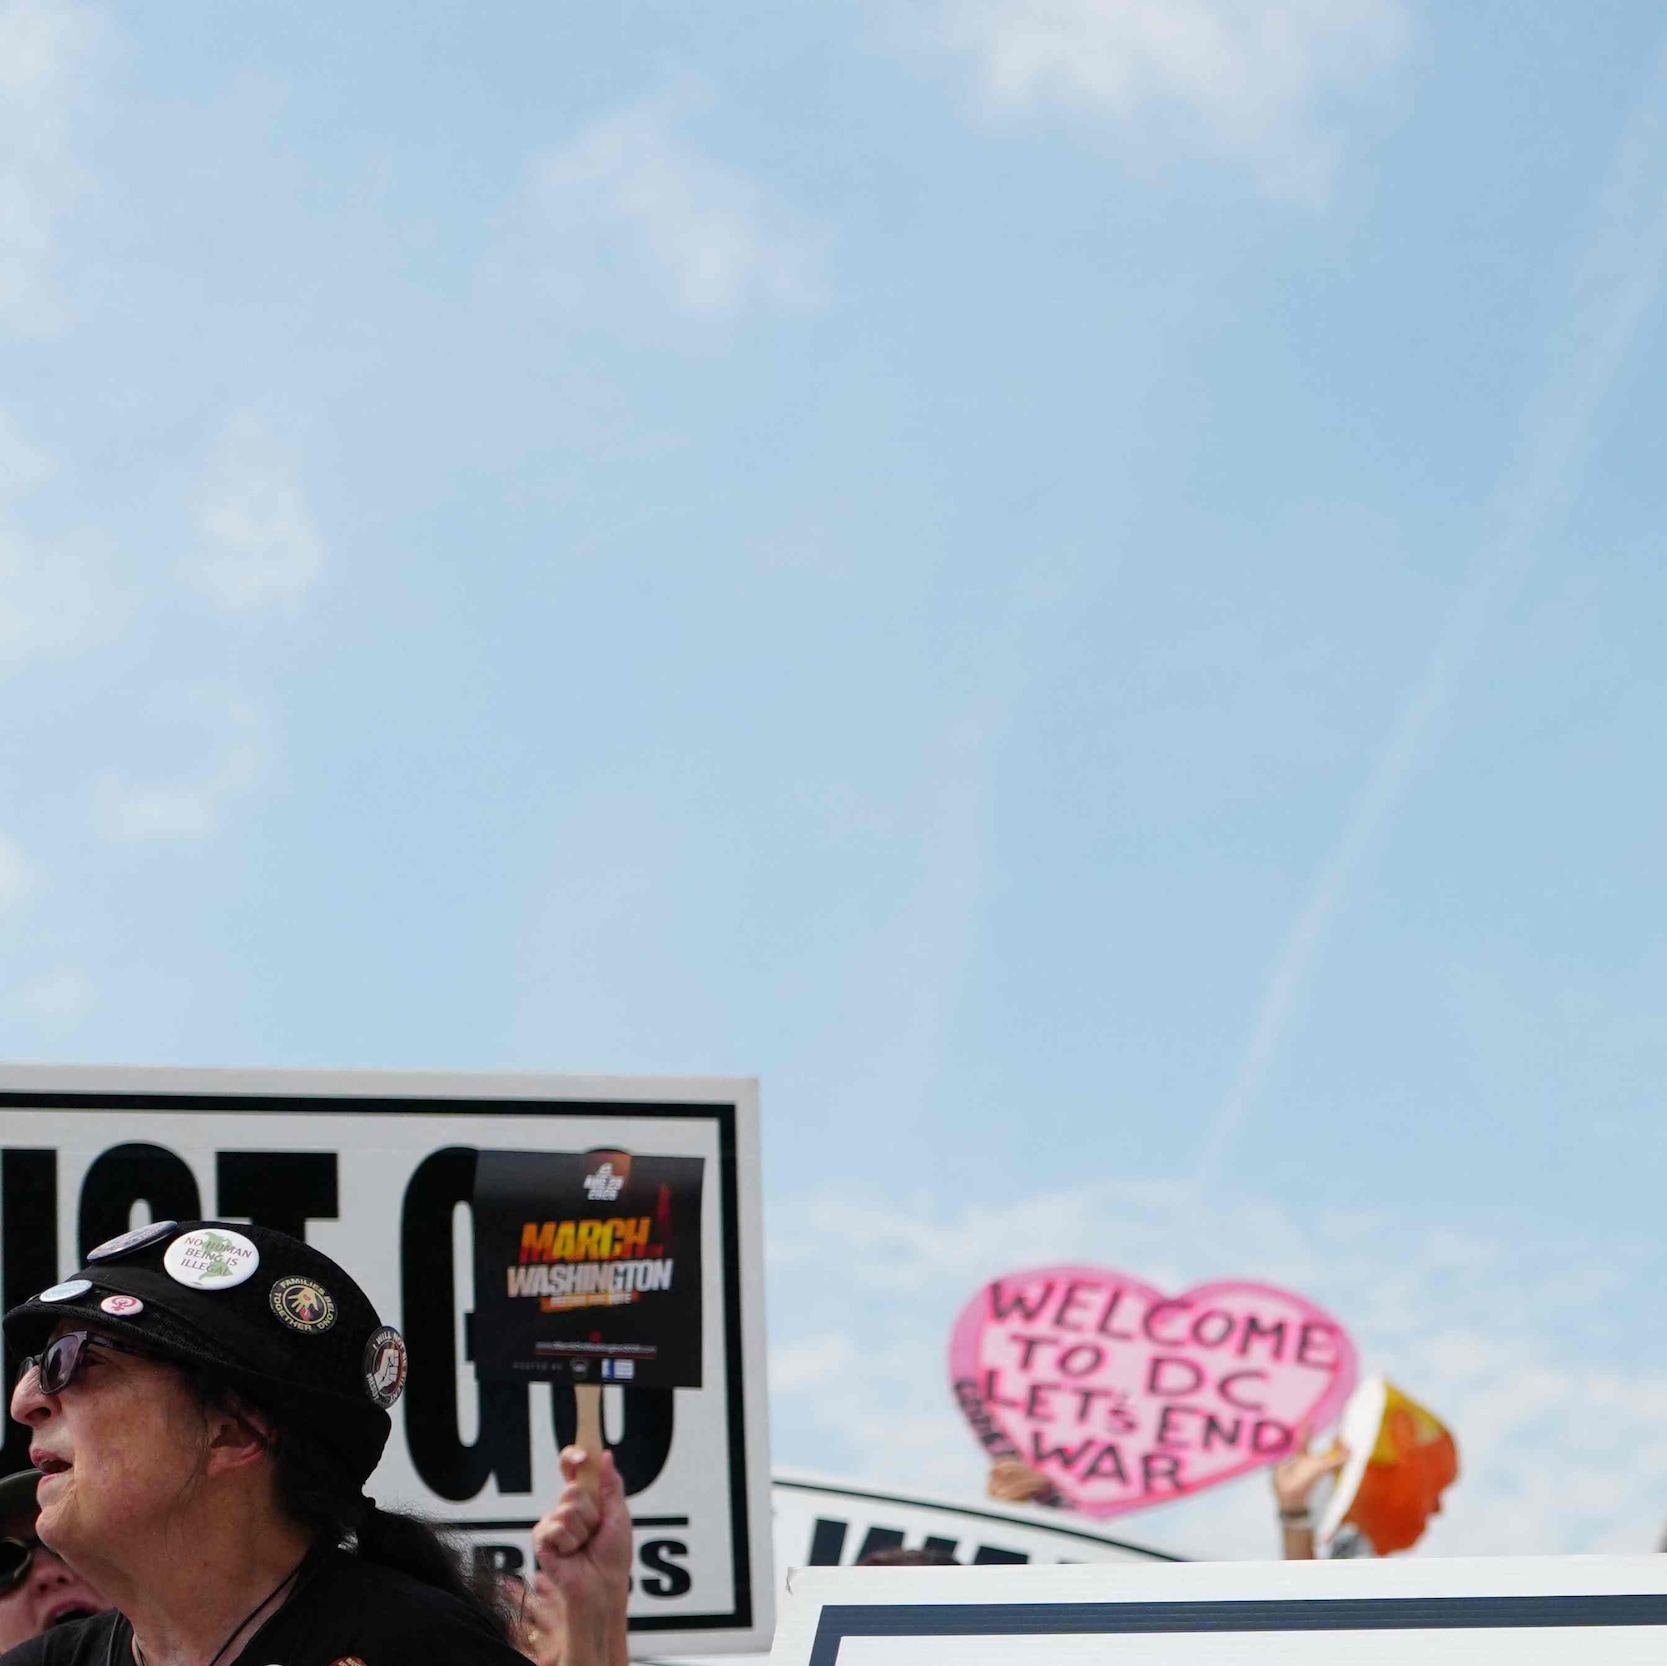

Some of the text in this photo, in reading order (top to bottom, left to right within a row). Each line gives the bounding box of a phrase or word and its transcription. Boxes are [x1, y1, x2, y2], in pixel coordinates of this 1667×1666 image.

[185, 1237, 252, 1258] NO HUMAN
[185, 1248, 238, 1266] BEING IS
[519, 1217, 650, 1264] MARCH
[180, 1258, 230, 1275] ILLEGAL
[507, 1258, 674, 1298] WASHINGTON
[273, 1278, 335, 1331] FAMILIES BELONG TOGETHER
[989, 1281, 1340, 1370] WELCOME
[1011, 1334, 1266, 1411] TO DC
[1157, 1406, 1293, 1453] END
[1032, 1432, 1184, 1490] WAR
